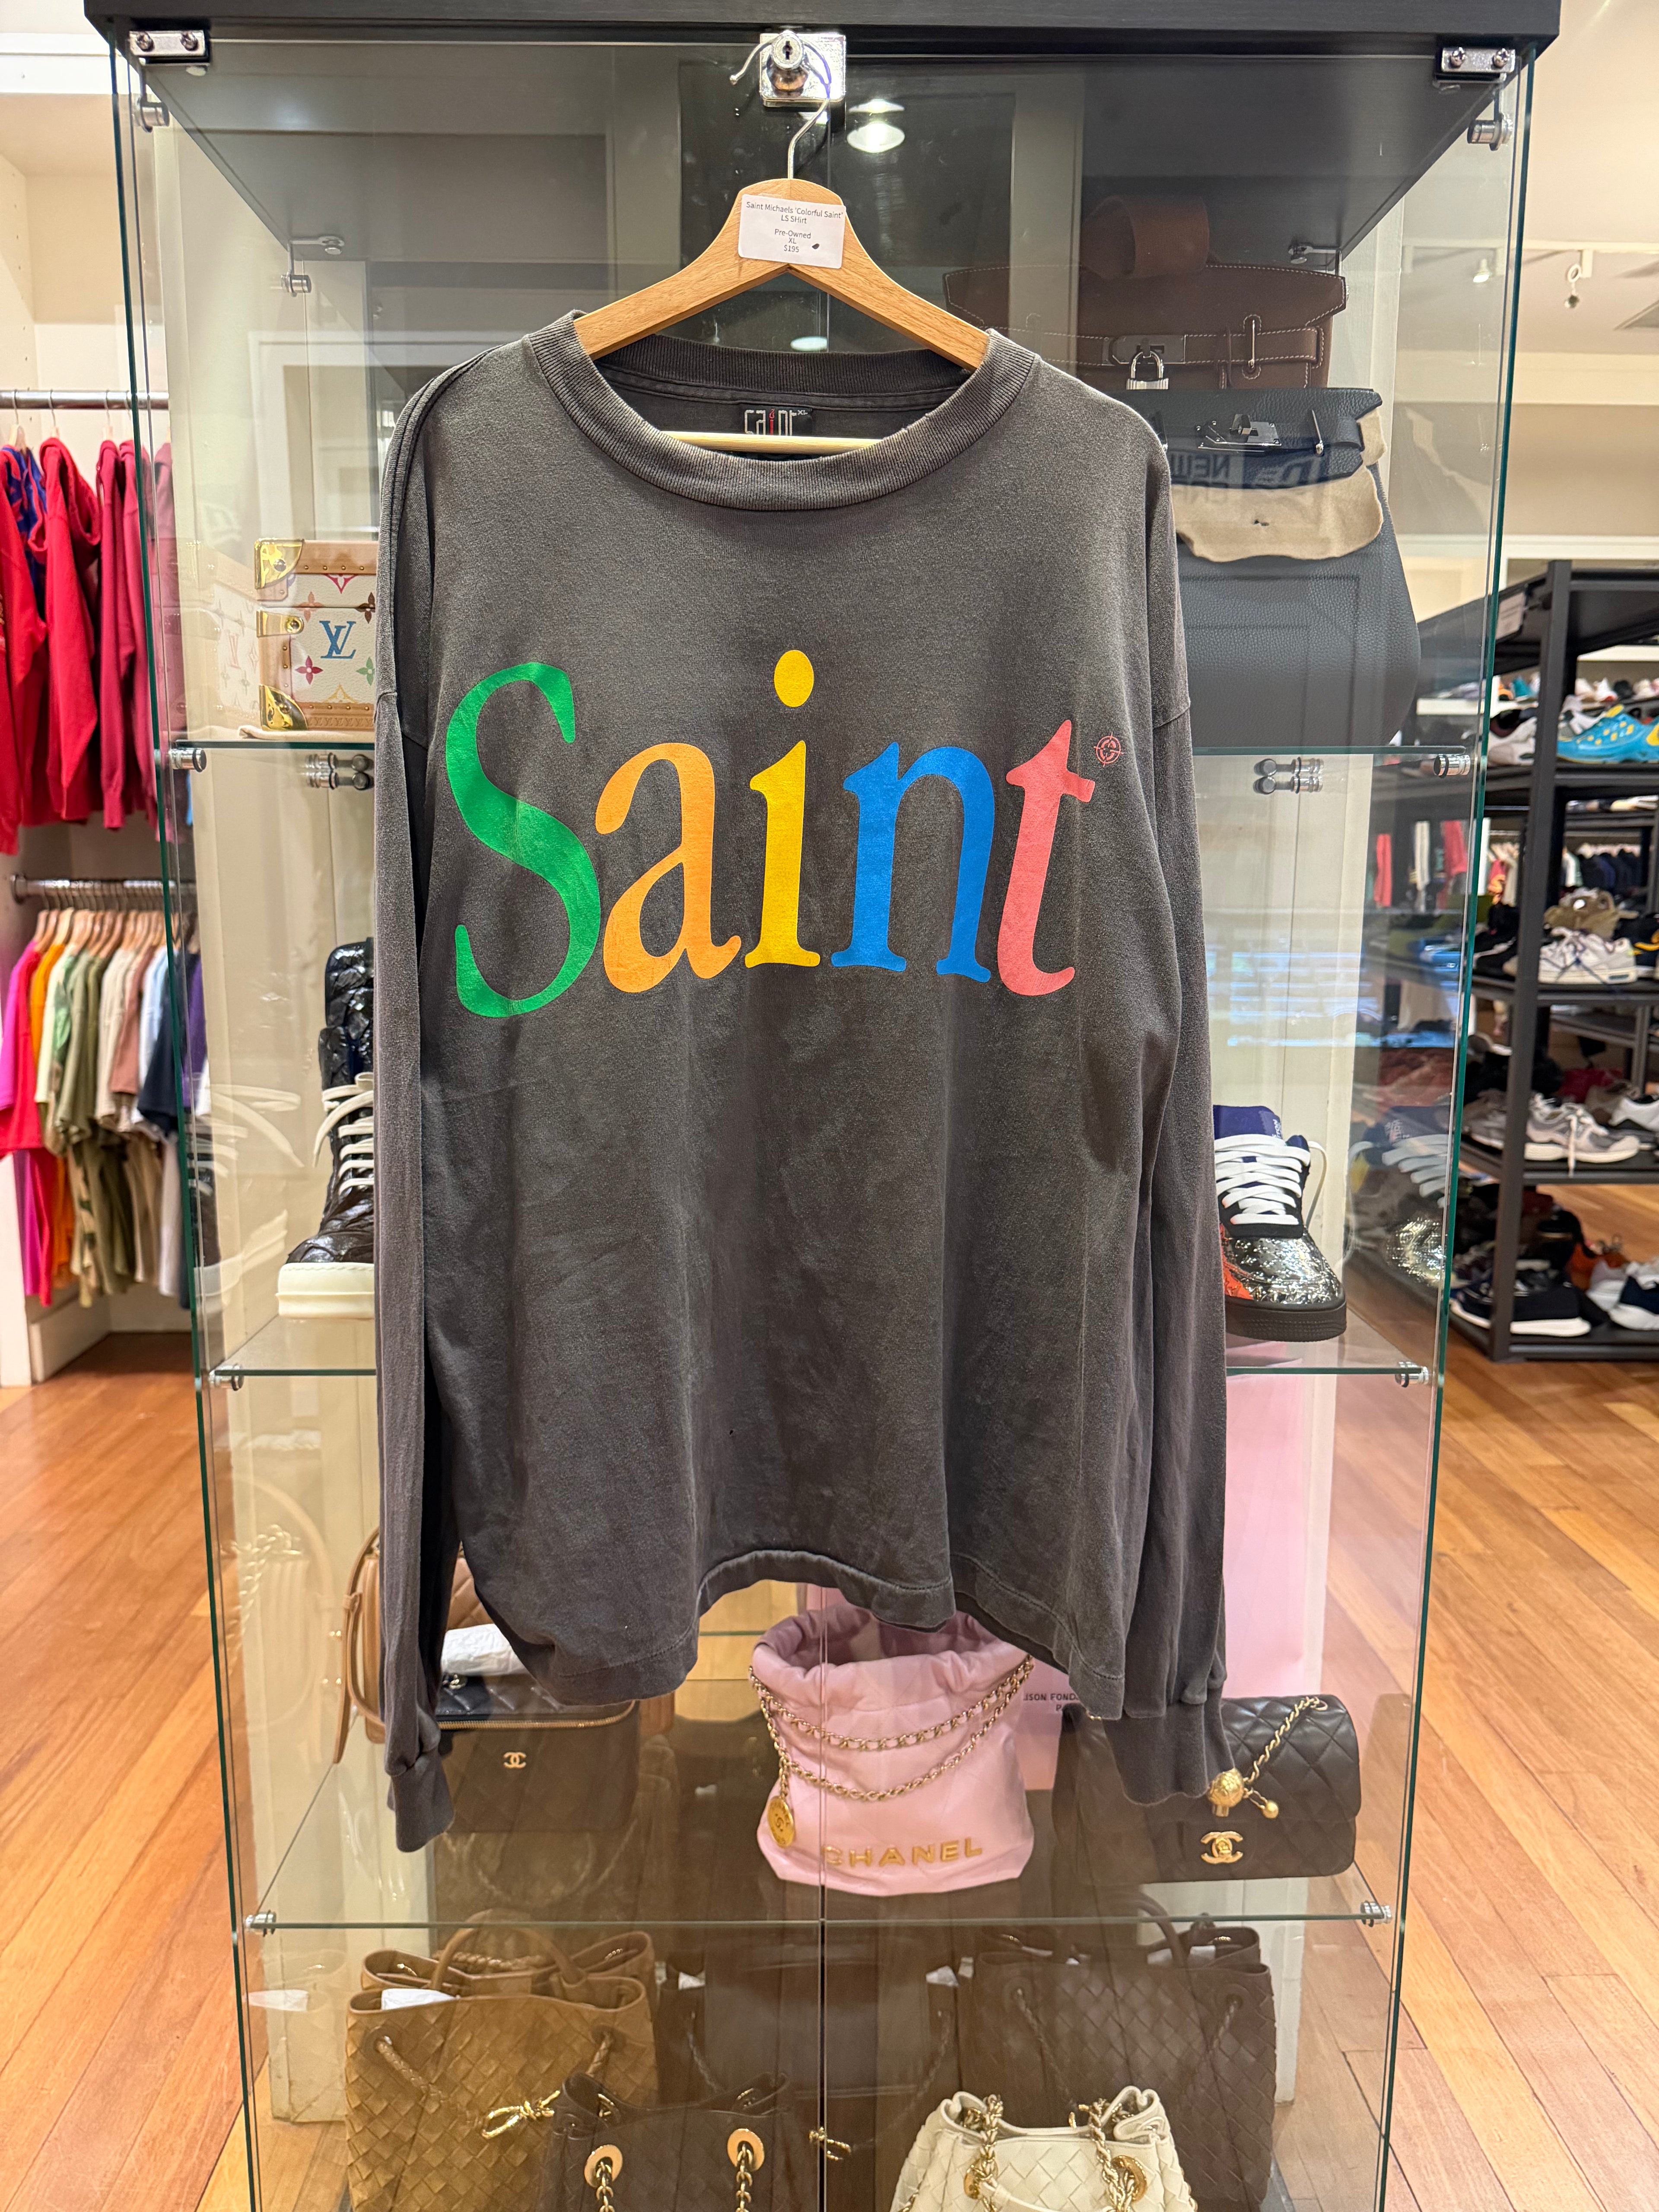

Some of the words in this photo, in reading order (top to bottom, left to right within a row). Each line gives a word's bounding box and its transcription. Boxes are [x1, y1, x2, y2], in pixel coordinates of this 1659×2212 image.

[746, 202, 763, 210] Saint
[765, 205, 793, 214] Michaels
[795, 207, 822, 217] 'Colorful
[790, 216, 807, 224] SHirt
[775, 229, 811, 239] Pre-Owned
[784, 245, 799, 253] $195
[445, 649, 1095, 1018] Saint
[823, 1837, 982, 1869] CHANEL
